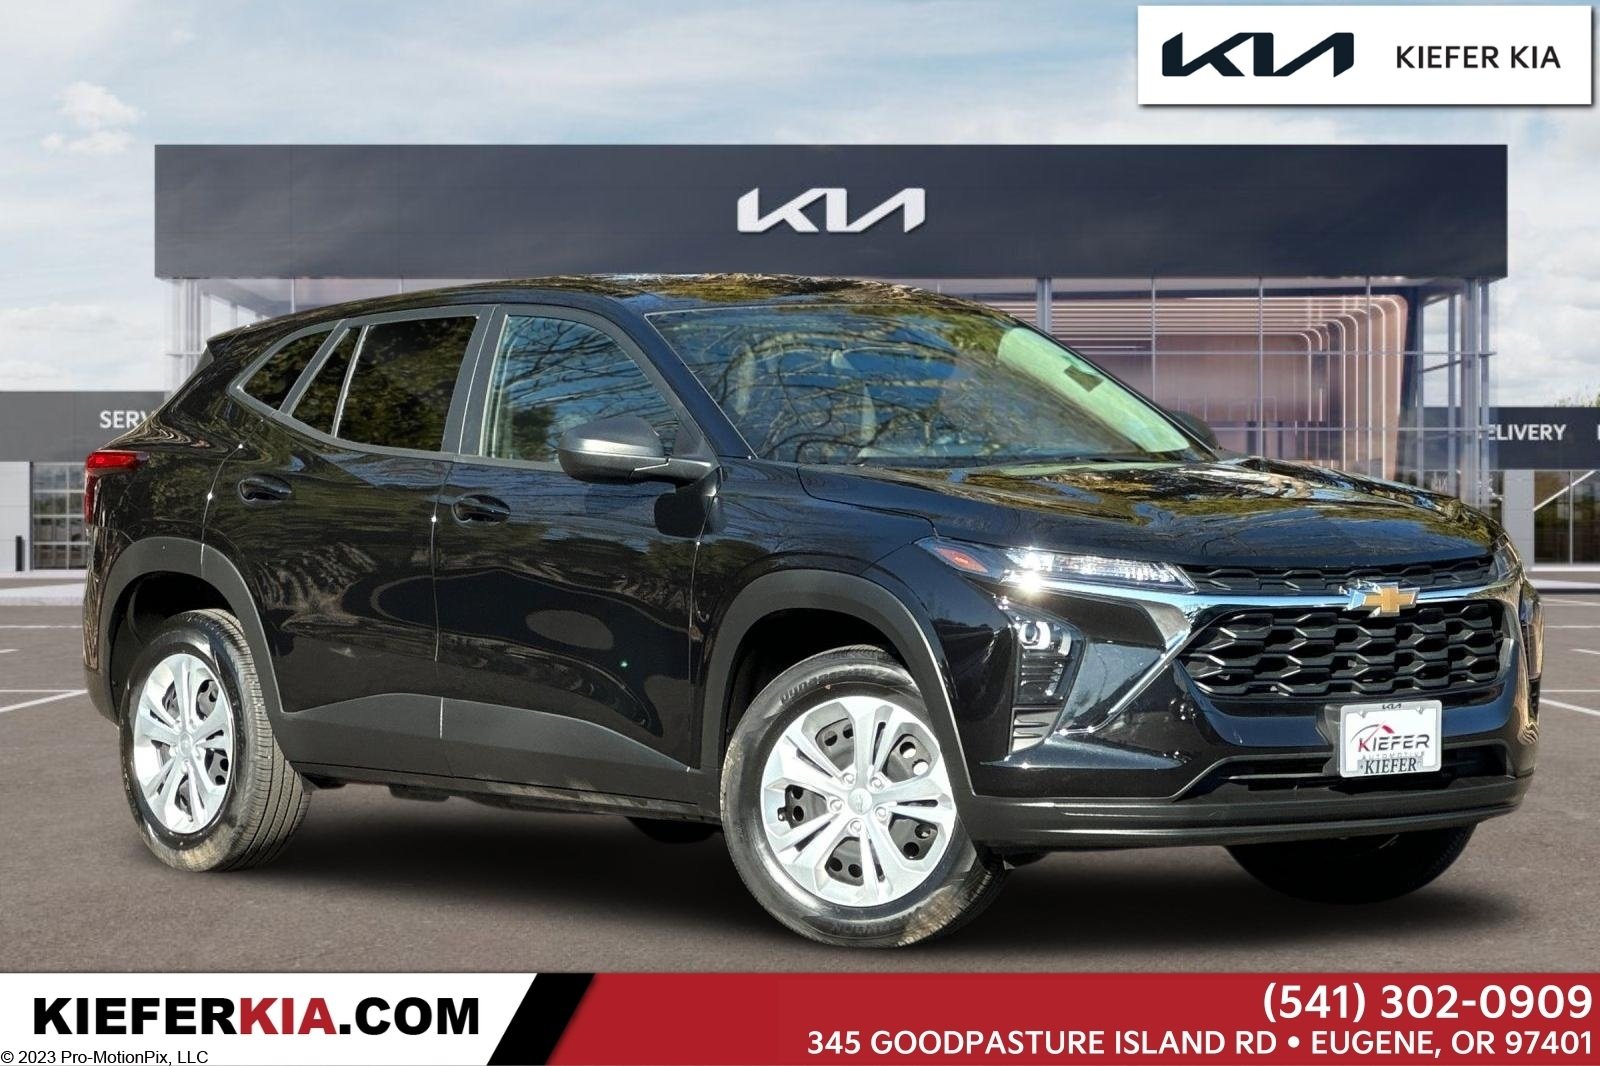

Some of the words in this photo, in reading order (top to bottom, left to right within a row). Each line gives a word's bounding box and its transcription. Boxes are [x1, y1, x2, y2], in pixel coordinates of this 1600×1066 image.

[737, 187, 926, 233] KIA
[1357, 731, 1430, 753] KIEFER
[1364, 757, 1417, 775] KIEFER
